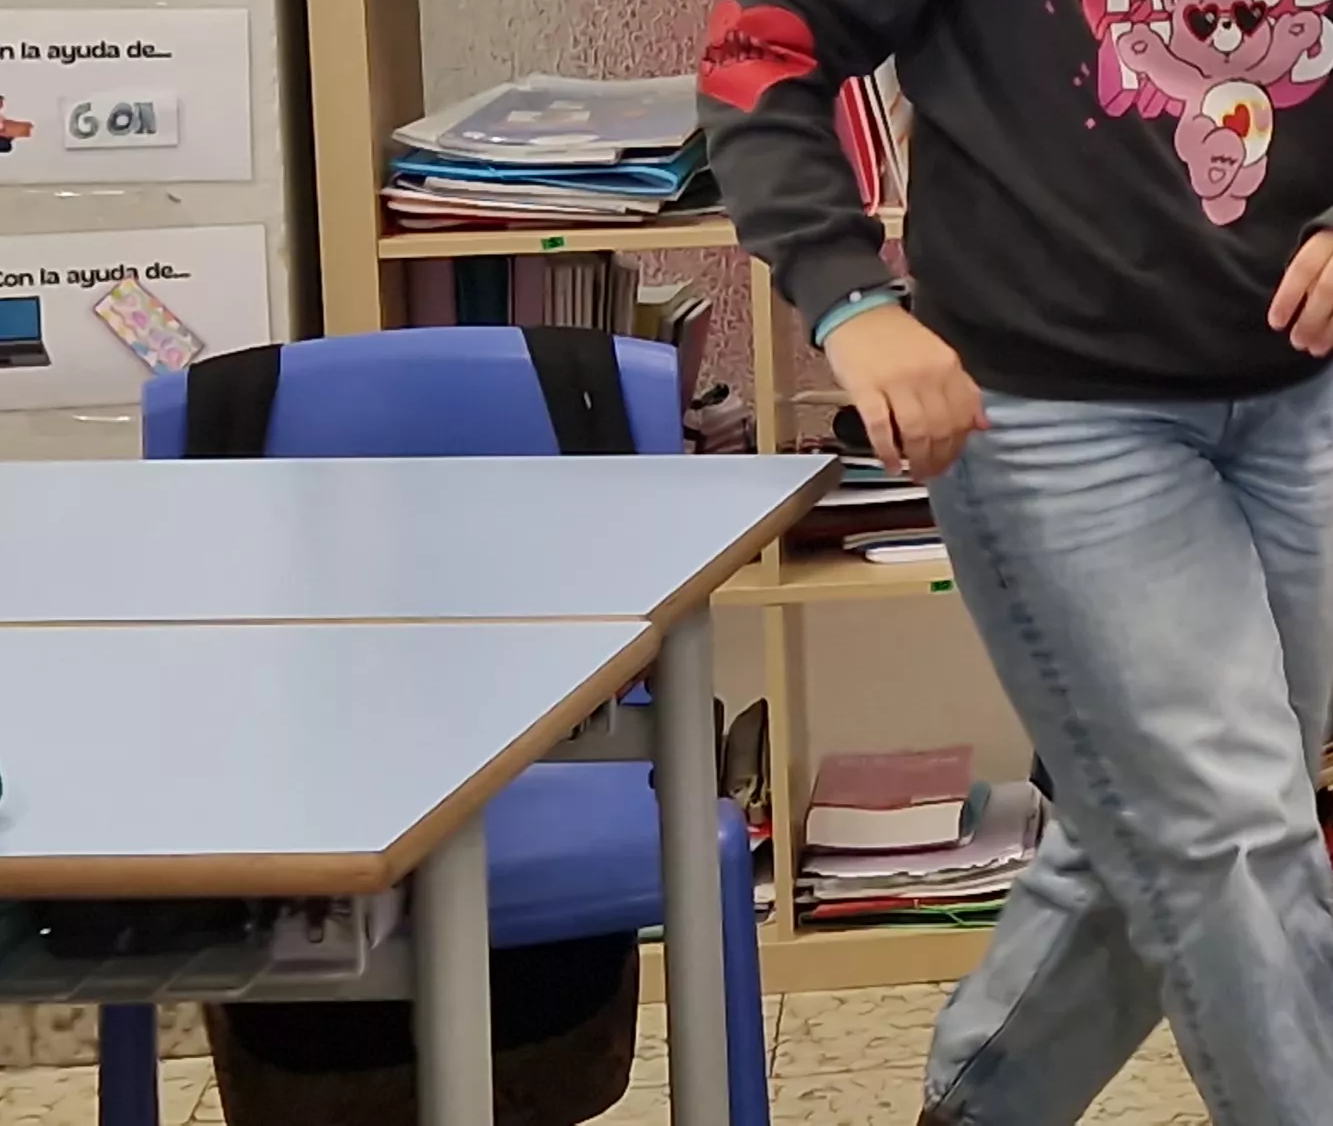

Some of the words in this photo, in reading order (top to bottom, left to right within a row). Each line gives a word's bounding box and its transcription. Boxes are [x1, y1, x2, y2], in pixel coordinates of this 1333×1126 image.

[21, 42, 41, 60] la
[47, 40, 120, 65] ayuda
[0, 269, 34, 288] on
[40, 268, 60, 286] la
[67, 263, 139, 288] ayuda
